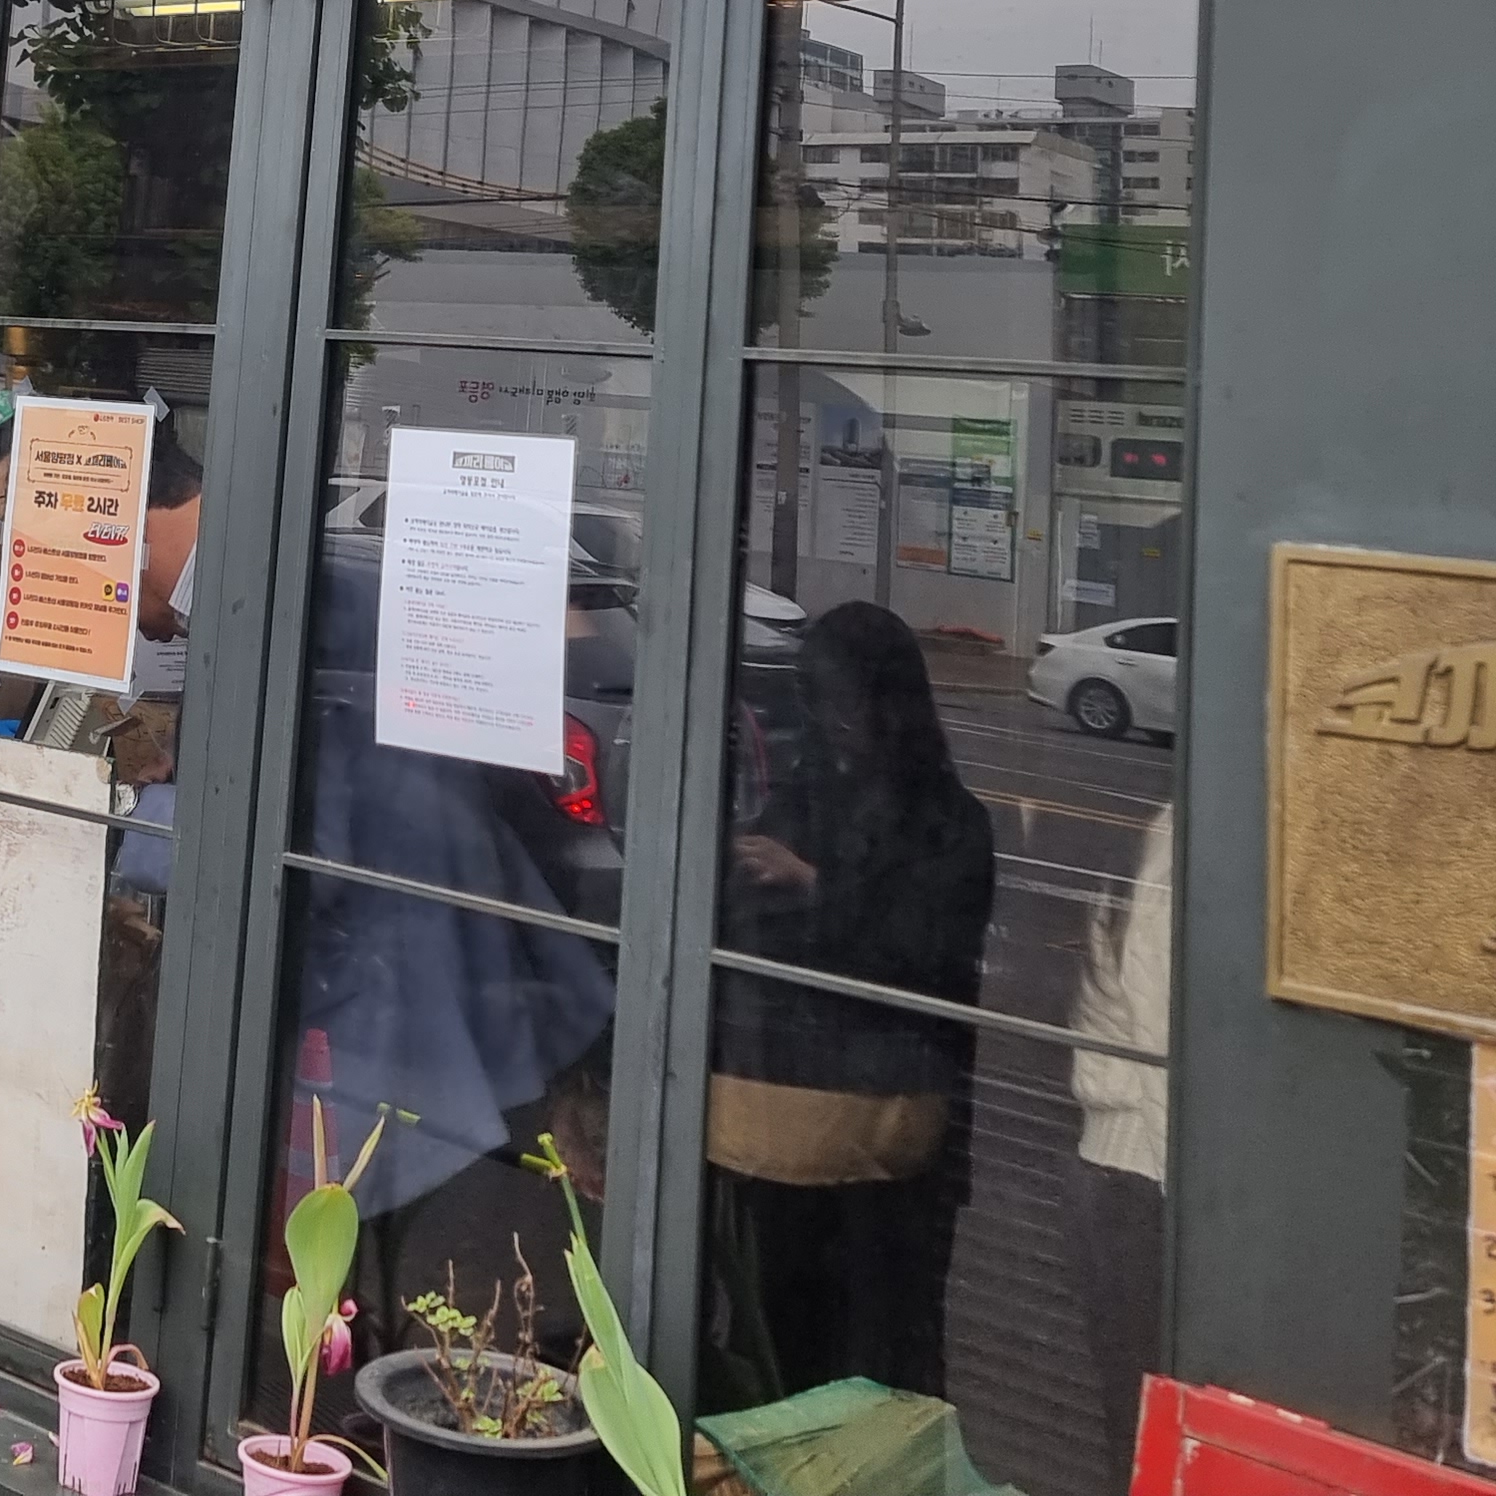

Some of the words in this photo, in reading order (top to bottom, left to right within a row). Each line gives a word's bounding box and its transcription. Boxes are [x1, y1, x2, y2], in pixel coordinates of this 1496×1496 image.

[76, 455, 83, 465] X
[34, 490, 58, 509] 주차
[61, 493, 84, 512] 무료
[87, 496, 119, 516] 2시간
